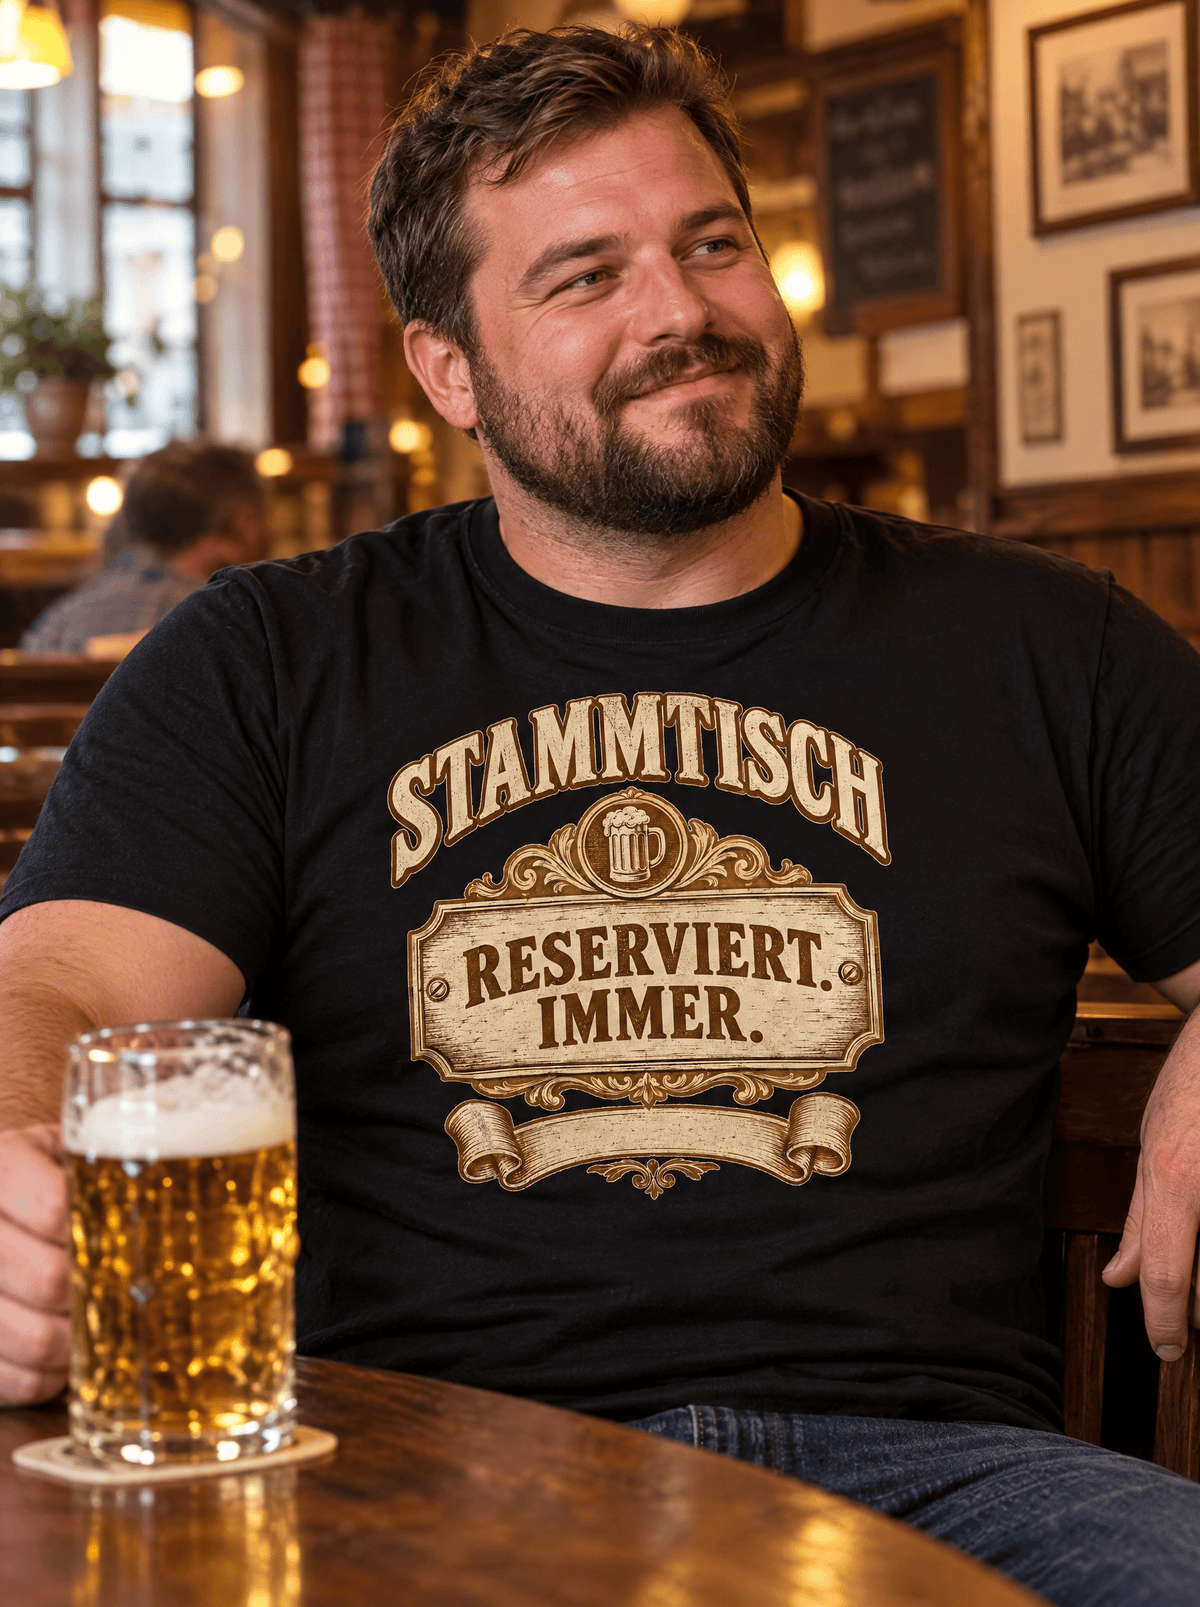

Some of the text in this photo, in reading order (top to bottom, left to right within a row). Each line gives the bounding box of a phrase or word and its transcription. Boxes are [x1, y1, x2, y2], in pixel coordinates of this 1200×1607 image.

[388, 692, 891, 888] STAMMTISCH
[463, 922, 833, 1009] RESERVIERT.
[537, 985, 763, 1049] IMMER.
